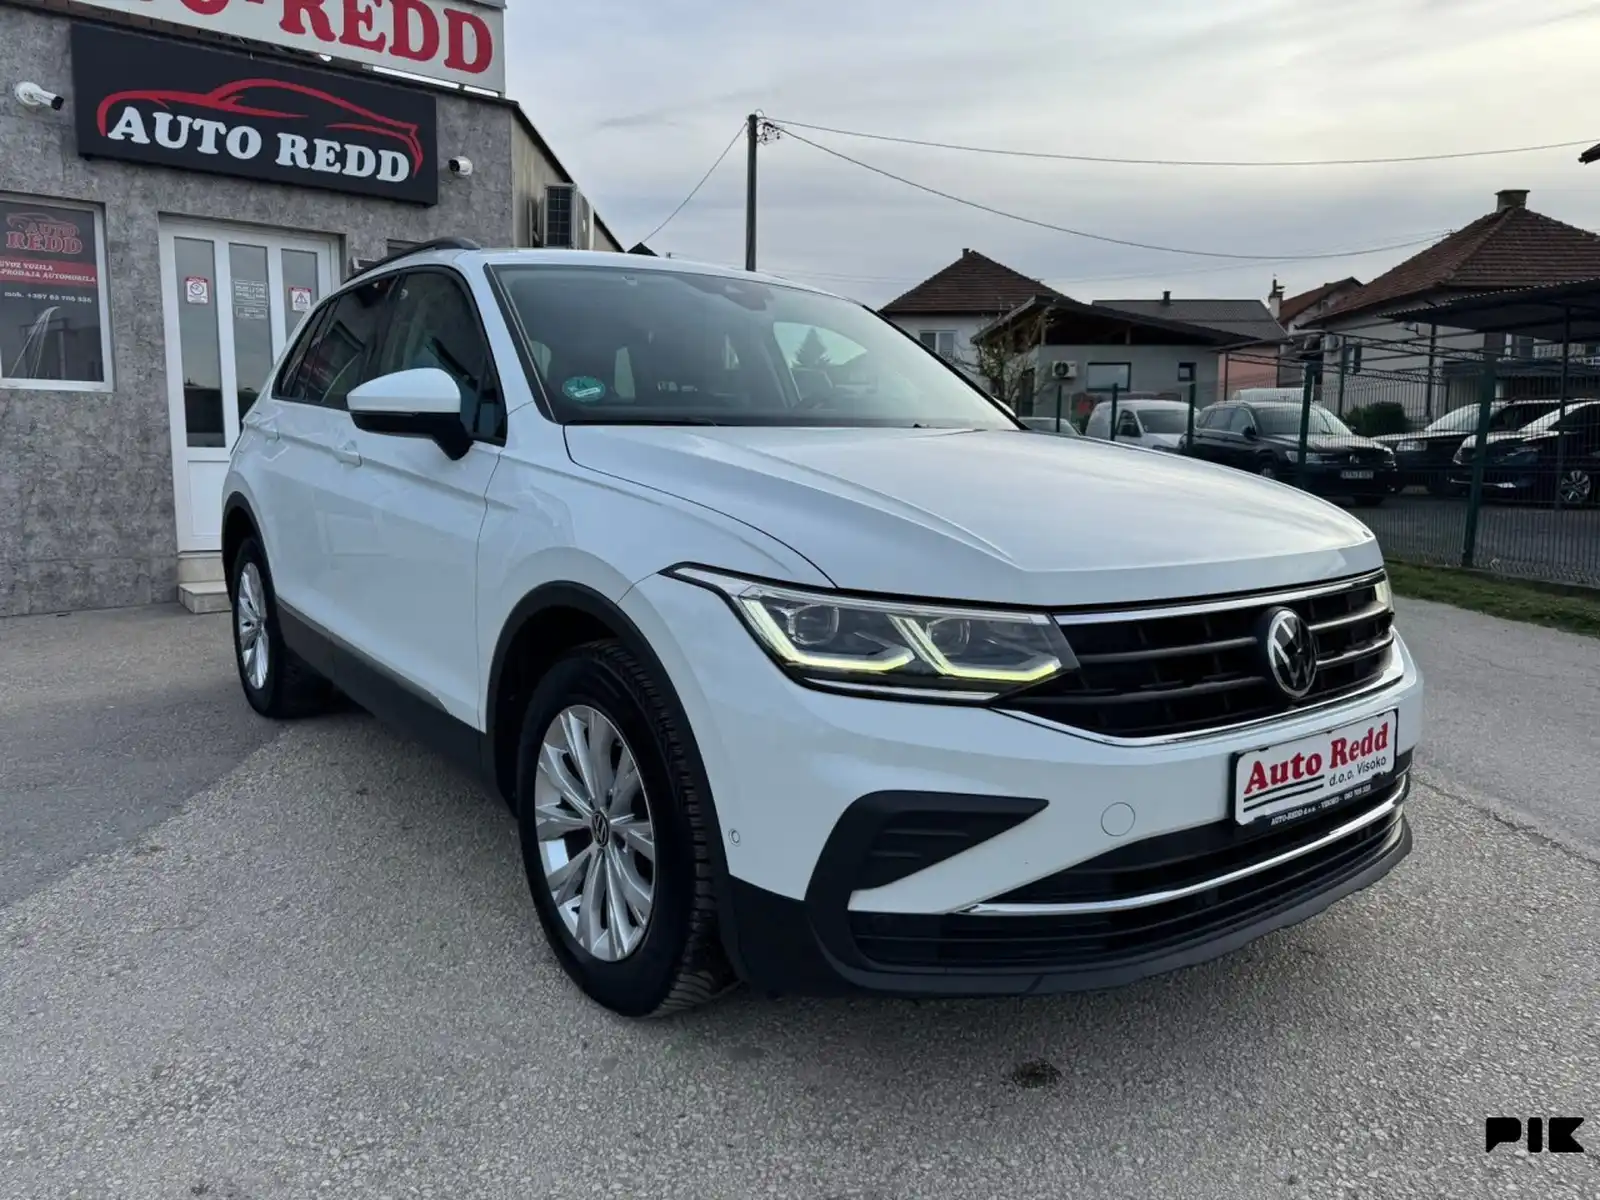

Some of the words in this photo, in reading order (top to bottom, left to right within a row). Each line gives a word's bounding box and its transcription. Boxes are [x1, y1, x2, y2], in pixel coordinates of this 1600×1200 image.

[180, 0, 493, 74] -REDD
[107, 106, 262, 160] AUTO
[275, 132, 411, 183] REDD
[6, 231, 83, 254] REDD
[25, 221, 78, 238] AUTO
[1243, 752, 1323, 795] Auto
[1329, 722, 1389, 769] Redd
[1329, 770, 1355, 787] d.o.o.
[1356, 756, 1387, 776] Visoko
